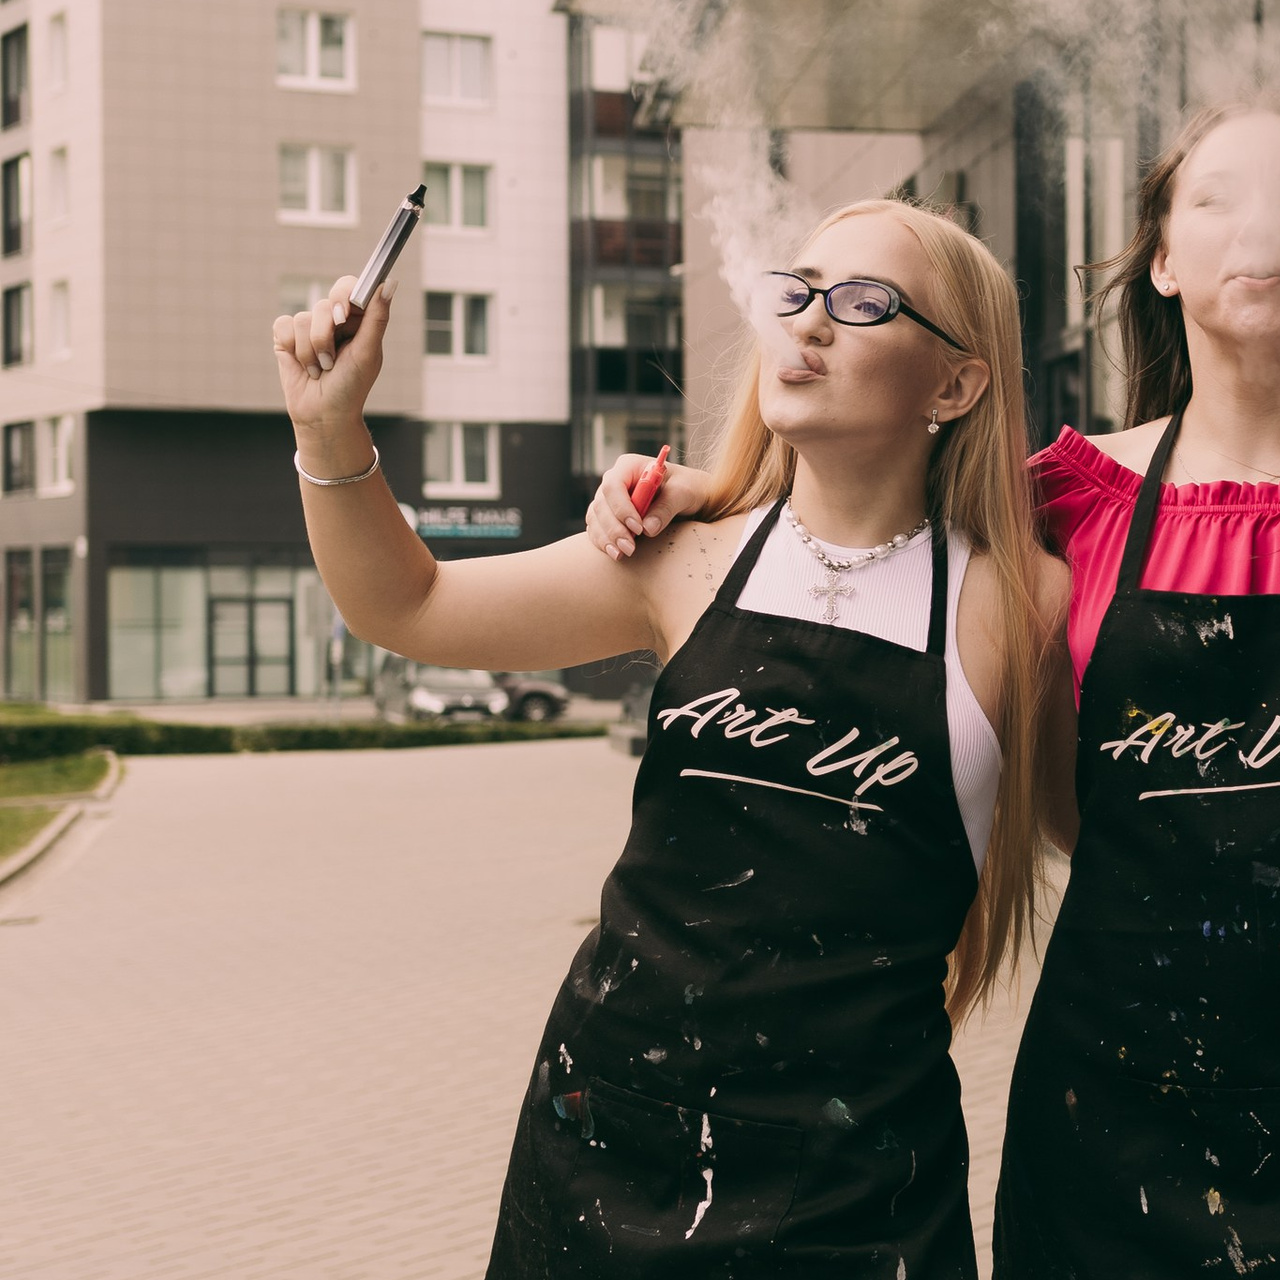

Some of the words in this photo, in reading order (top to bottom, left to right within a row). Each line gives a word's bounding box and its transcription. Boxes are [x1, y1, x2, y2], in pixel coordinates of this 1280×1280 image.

[657, 687, 816, 748] Art
[806, 727, 919, 796] Up
[1100, 712, 1246, 764] Art
